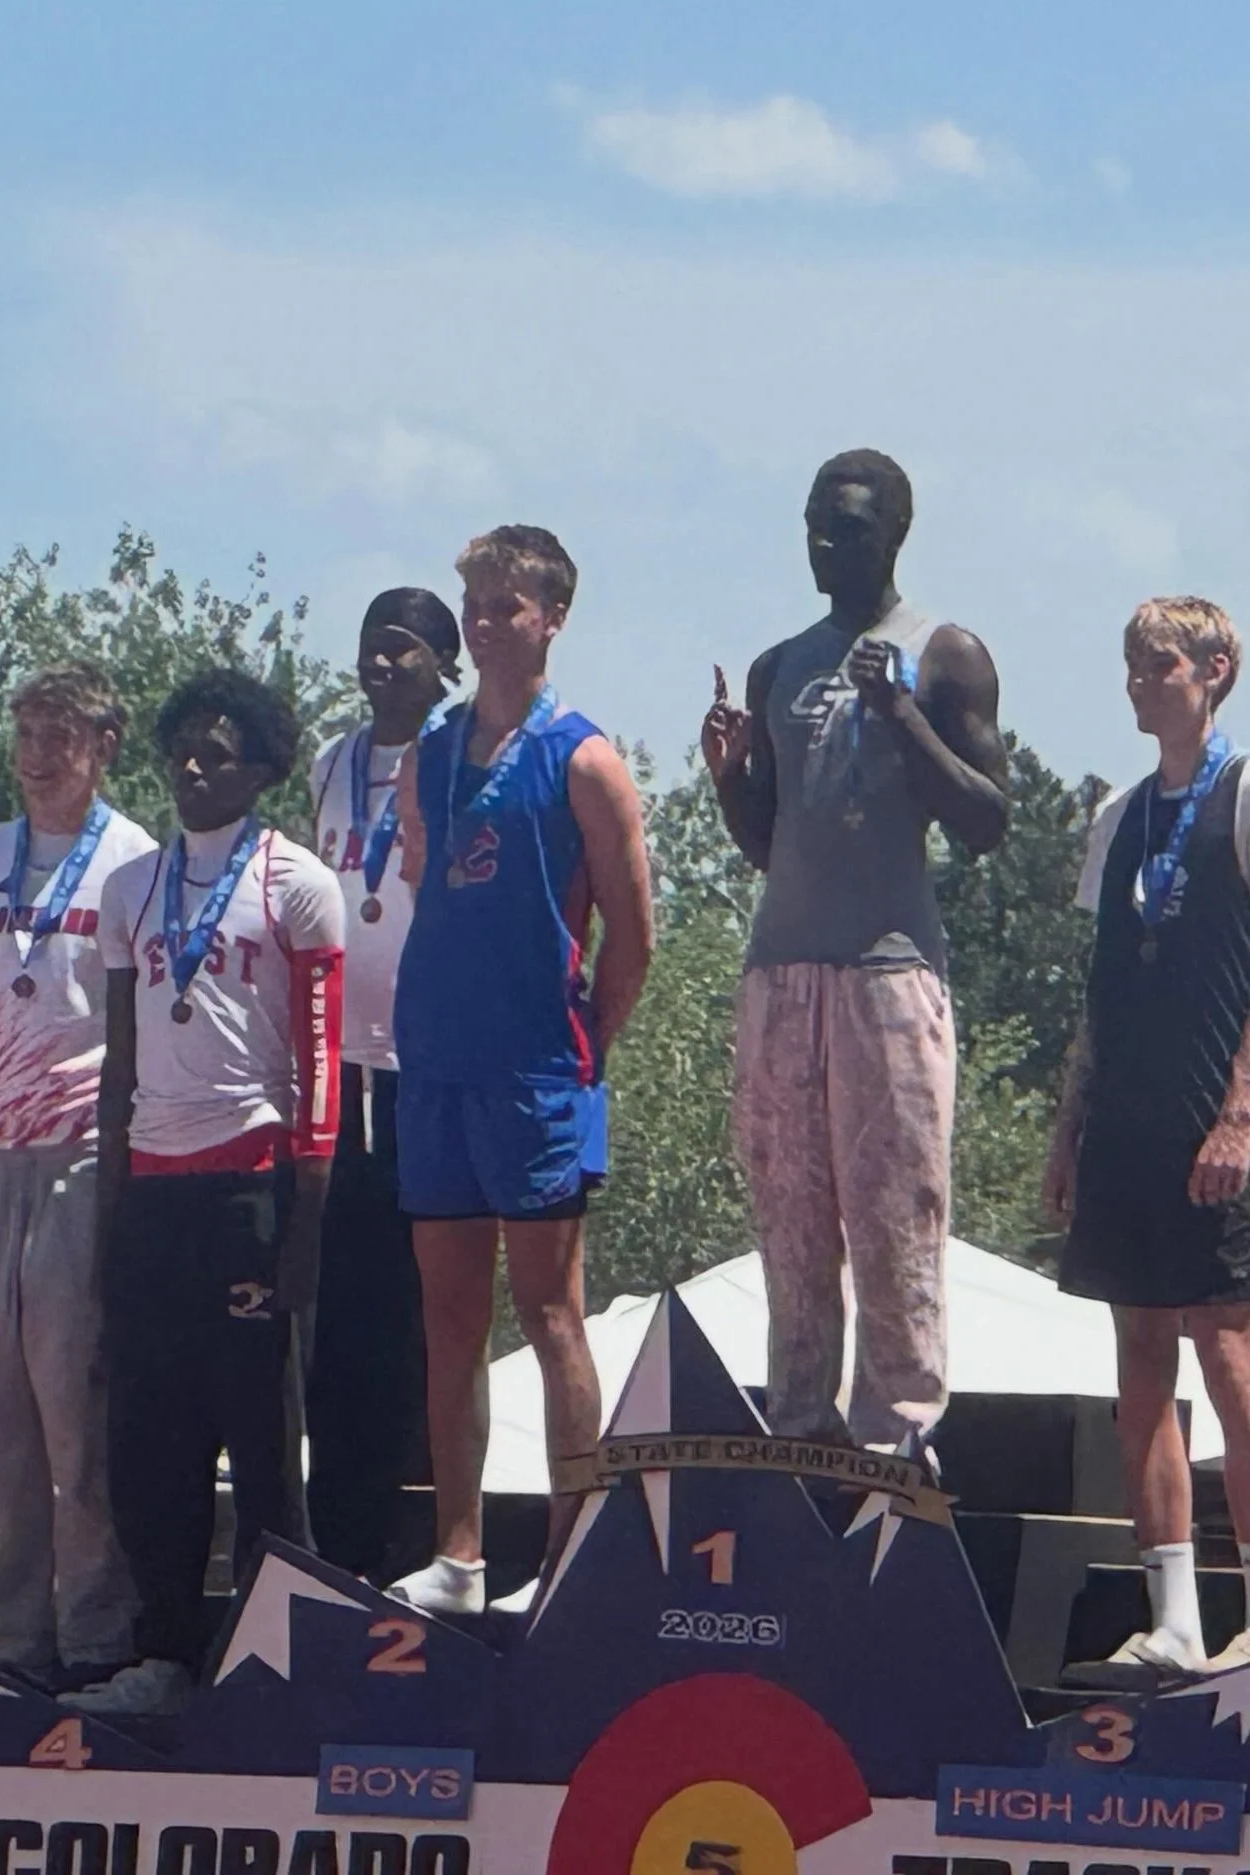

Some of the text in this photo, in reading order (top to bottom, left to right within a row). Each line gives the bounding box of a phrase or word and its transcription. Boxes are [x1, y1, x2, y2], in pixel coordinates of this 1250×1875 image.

[143, 928, 263, 988] EST
[607, 1438, 911, 1485] STATE CHAMPION
[692, 1530, 738, 1585] 1
[366, 1619, 429, 1675] 2
[657, 1609, 781, 1646] 2026
[29, 1714, 94, 1770] 4
[1075, 1702, 1136, 1764] 3
[328, 1763, 463, 1800] BOYS
[952, 1785, 1225, 1831] HIGH JUMP
